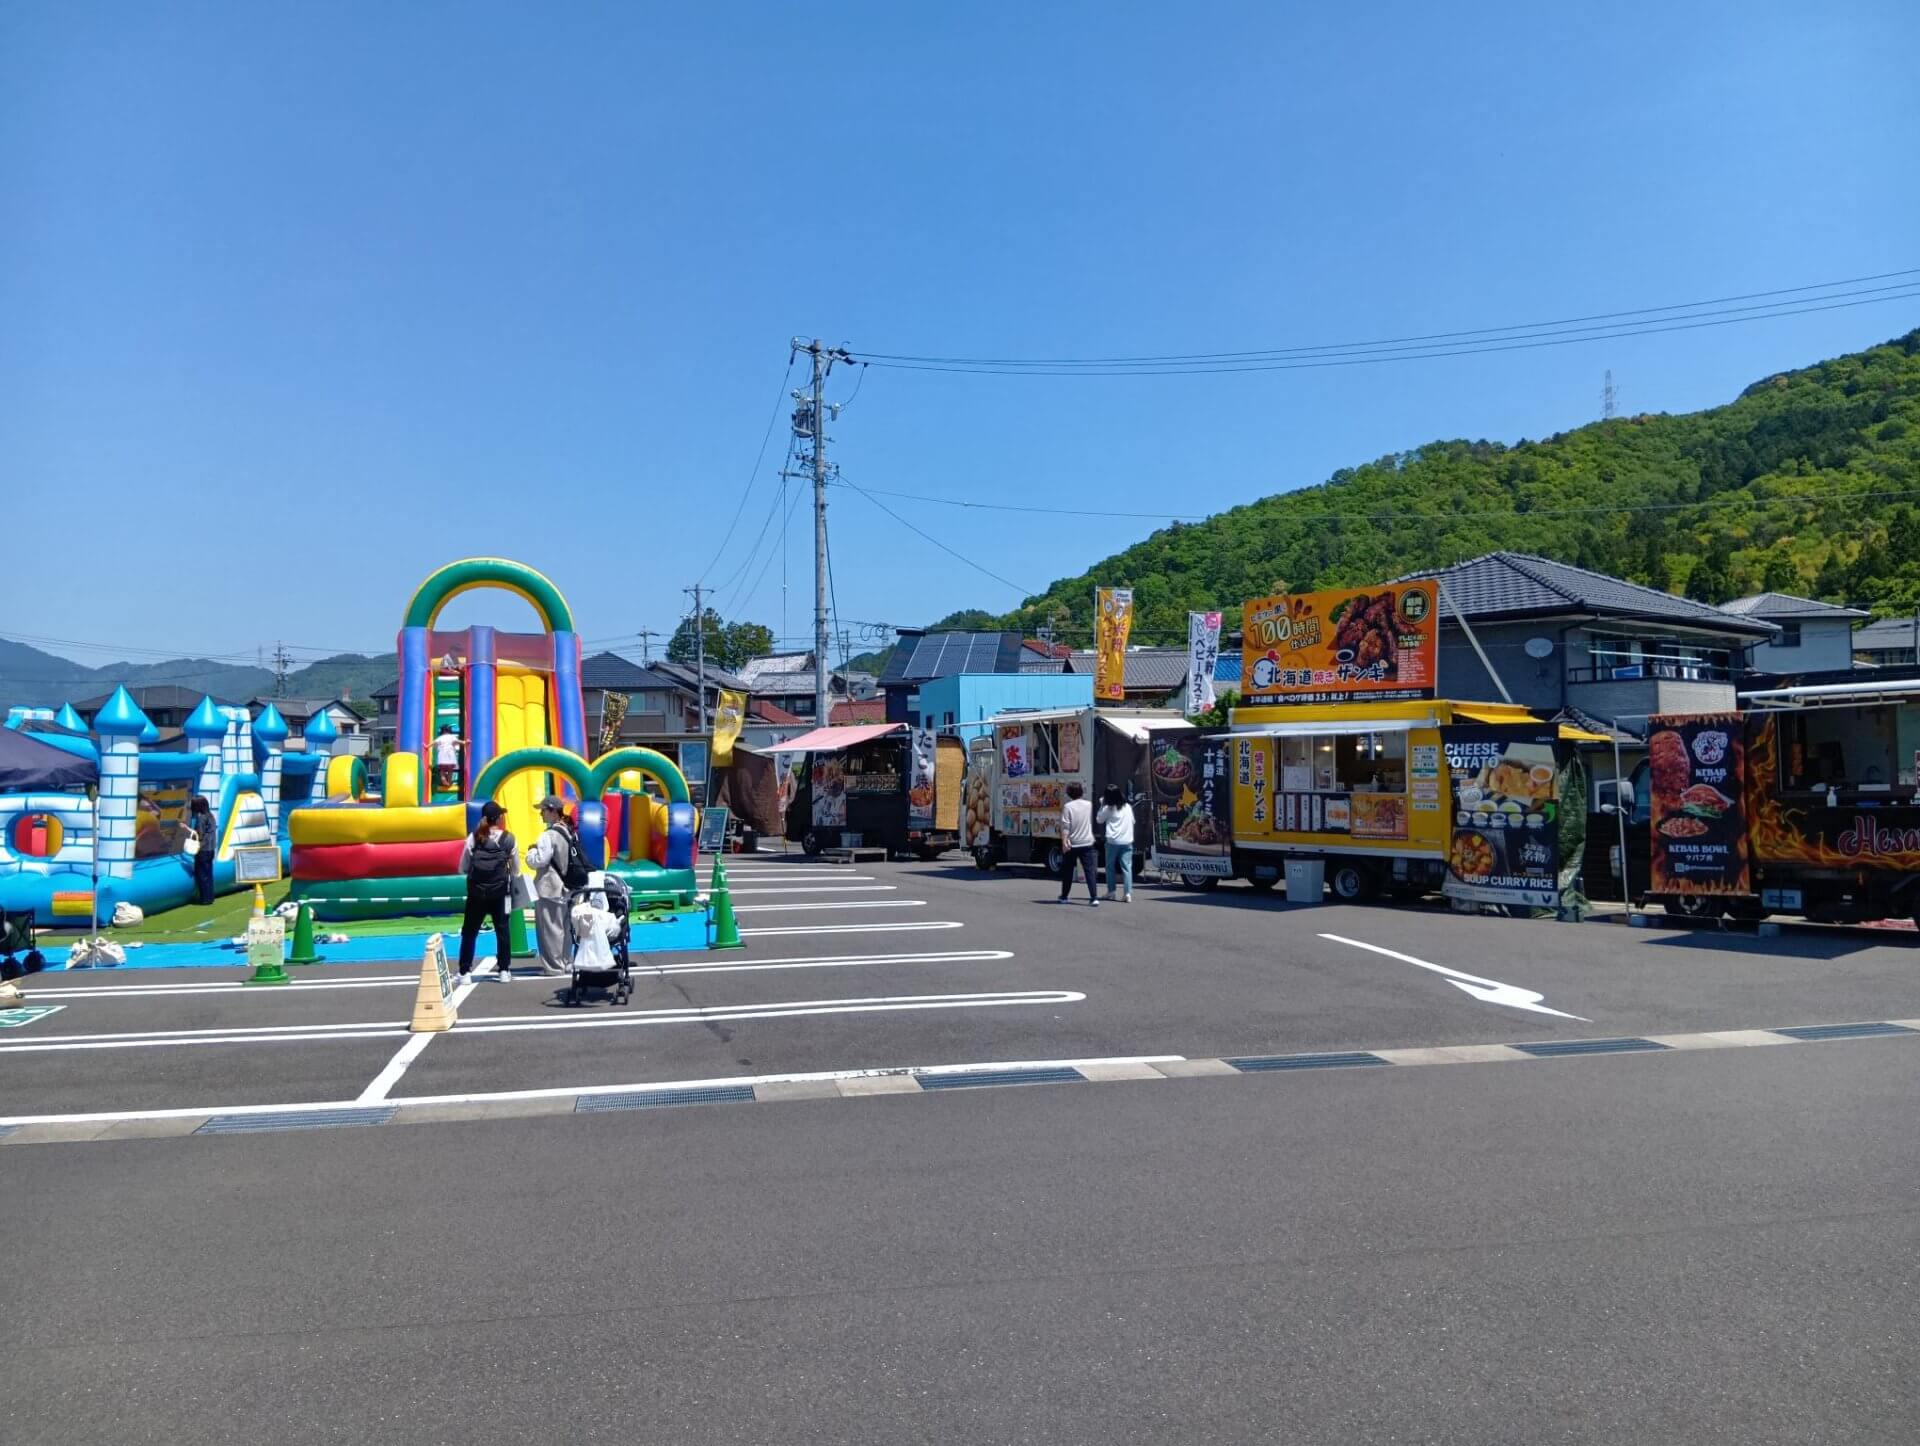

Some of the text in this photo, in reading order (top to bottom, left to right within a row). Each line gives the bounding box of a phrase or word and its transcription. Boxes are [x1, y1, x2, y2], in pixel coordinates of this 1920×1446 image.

[1444, 743, 1500, 756] CHEESE
[1239, 739, 1251, 786] 北海道
[1695, 768, 1727, 777] KEBAB
[1669, 845, 1729, 854] KEBAB BOWL
[1202, 862, 1228, 873] MENU
[1464, 873, 1554, 889] SOUP CURRY RICE
